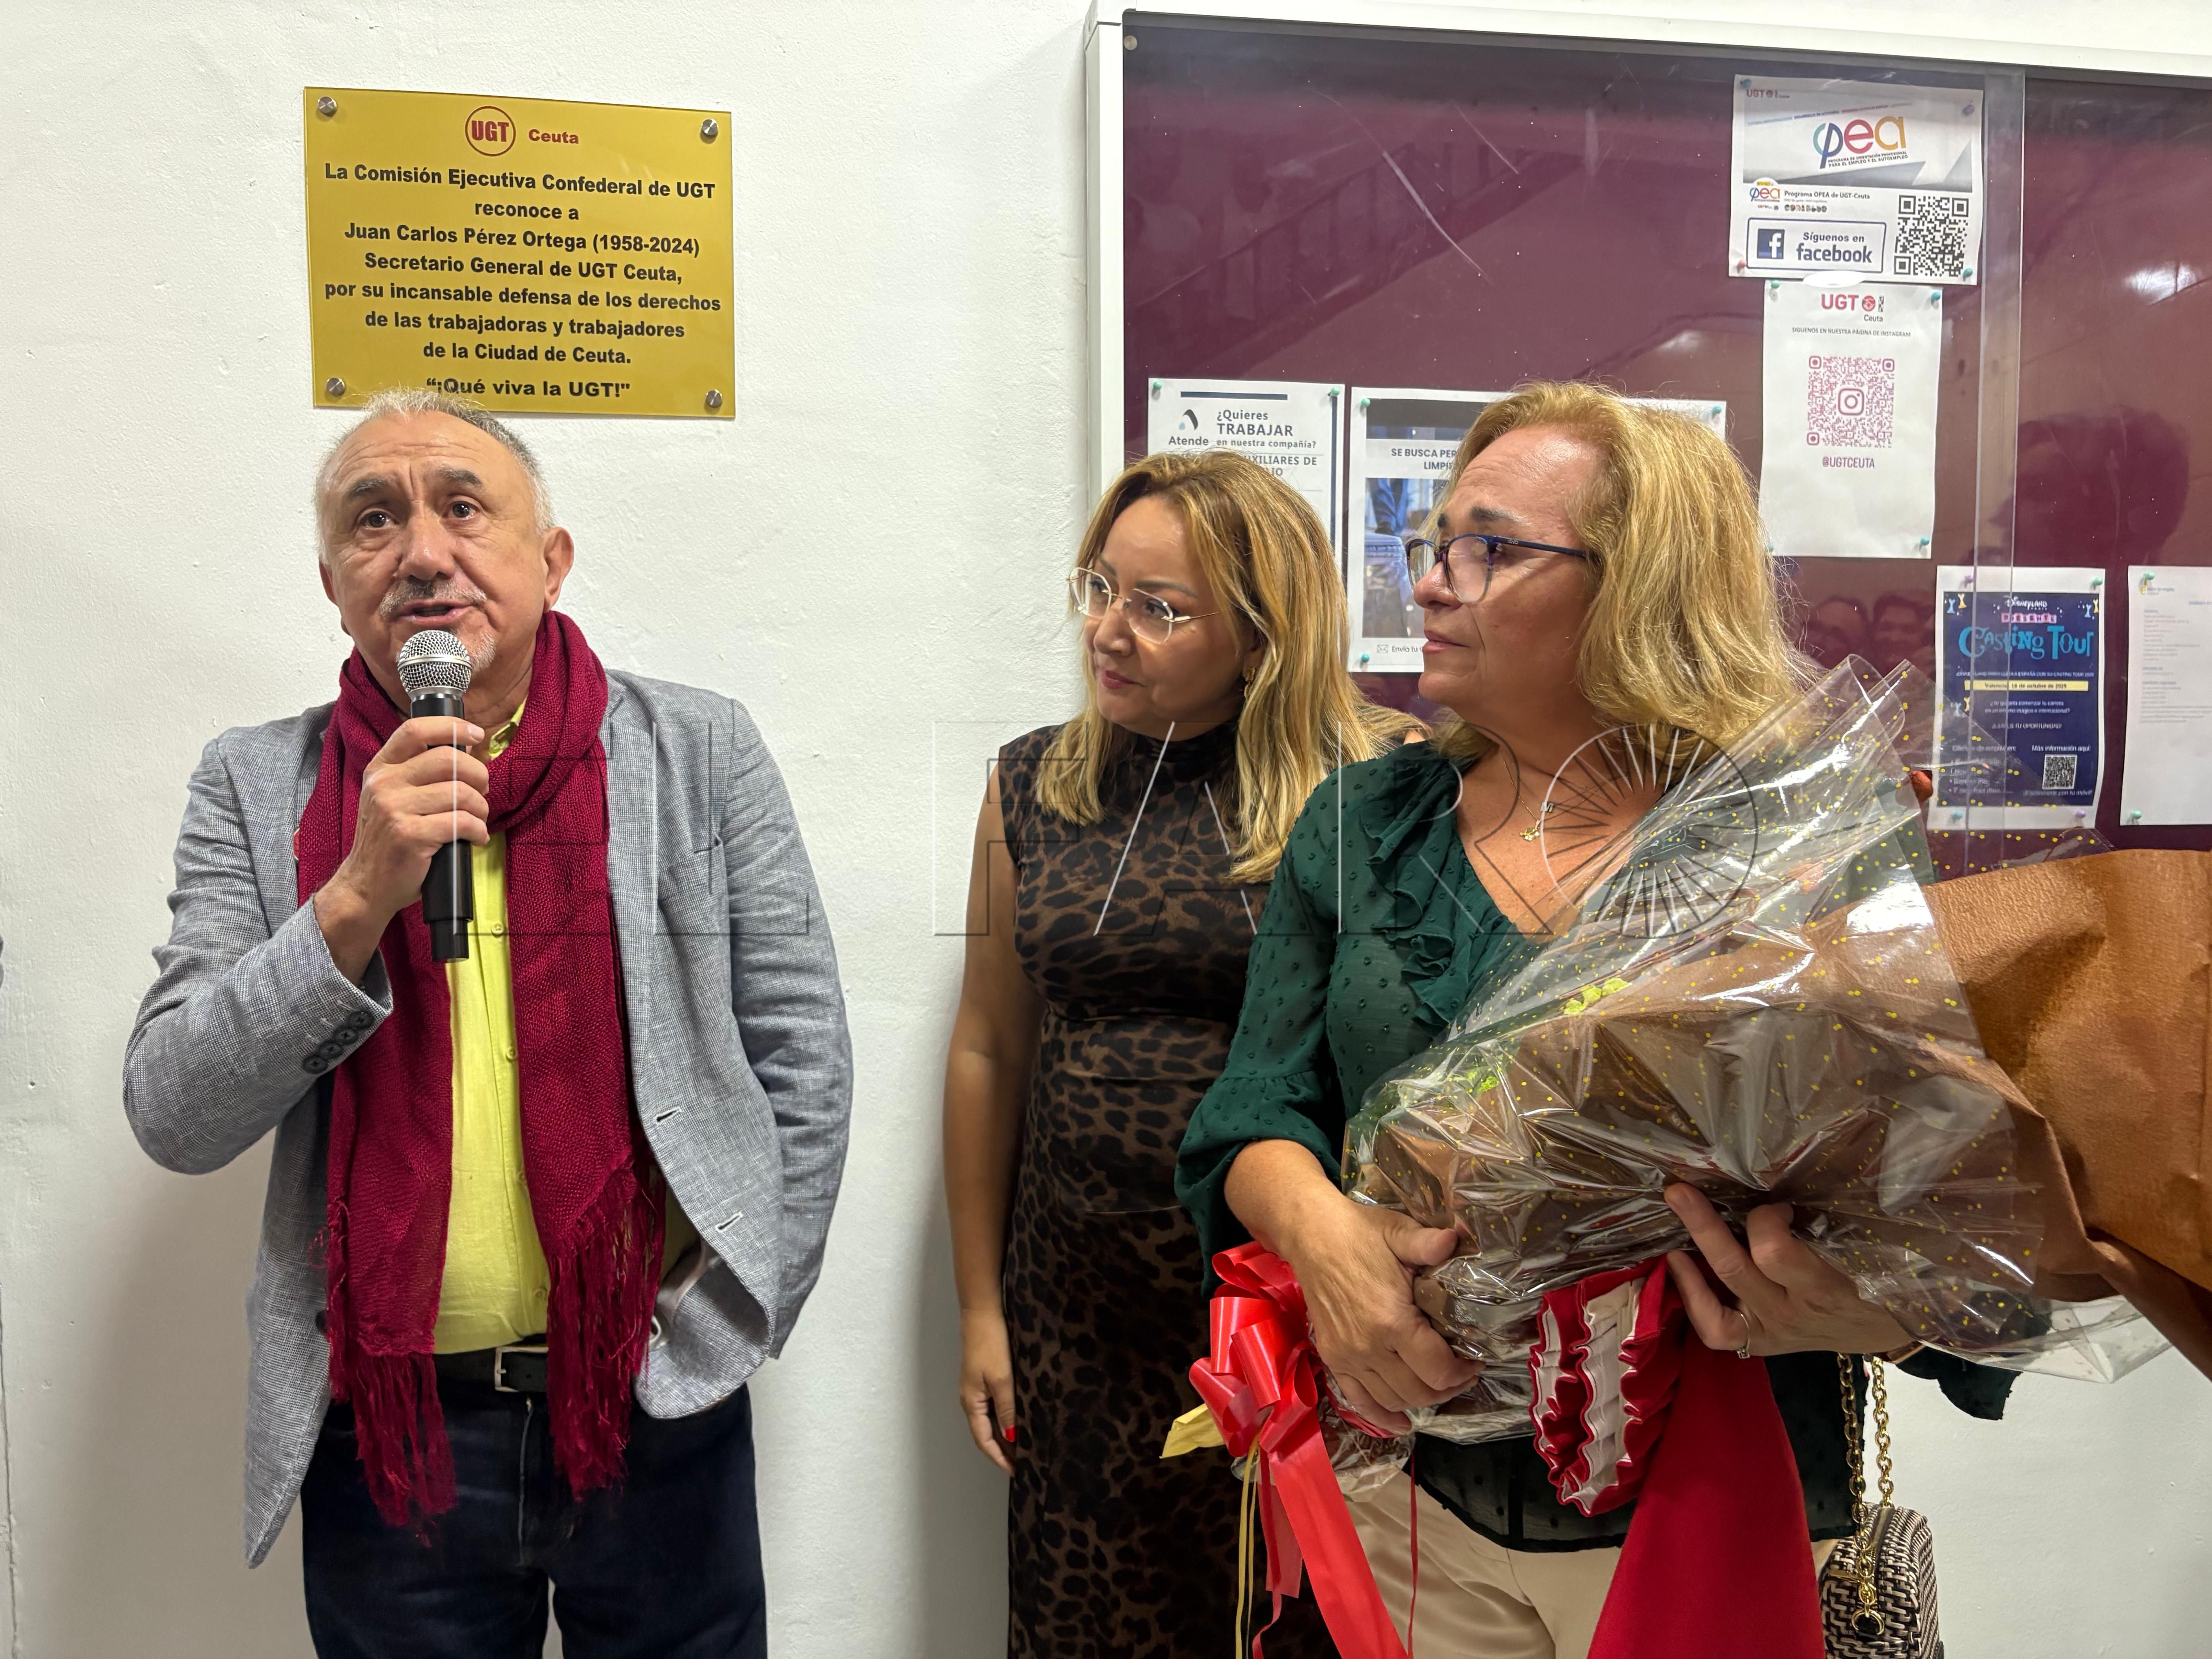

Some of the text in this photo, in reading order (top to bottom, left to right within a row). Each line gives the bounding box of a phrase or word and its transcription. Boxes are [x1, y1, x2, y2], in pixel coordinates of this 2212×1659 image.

[1746, 89, 1764, 98] UGT
[471, 120, 579, 144] UGT Ceuta
[325, 163, 715, 199] La Comisión Ejecutiva Confederal de UGT
[475, 203, 579, 220] reconoce a
[344, 222, 699, 258] Juan Carlos Pérez Ortega (1958-2024)
[1803, 232, 1864, 243] Síguenos en
[1796, 244, 1872, 264] facebook
[365, 252, 682, 285] Secretario General de UGT Ceuta,
[325, 282, 721, 311] por su incansable defensa de los derechos
[1821, 294, 1859, 311] UGT
[365, 311, 685, 340] de las trabajadoras y trabajadores
[423, 342, 631, 364] de la Ciudad de Ceuta.
[493, 380, 535, 395] viva
[543, 381, 561, 396] la
[569, 382, 630, 397] UGT!"
[1217, 409, 1268, 422] ¿Quieres
[1217, 423, 1293, 436] TRABAJAR
[1168, 436, 1209, 446] Atende
[1268, 441, 1316, 449] compañía?
[1405, 449, 1437, 457] BUSCA
[1822, 457, 1875, 469] @UGTCEUTA
